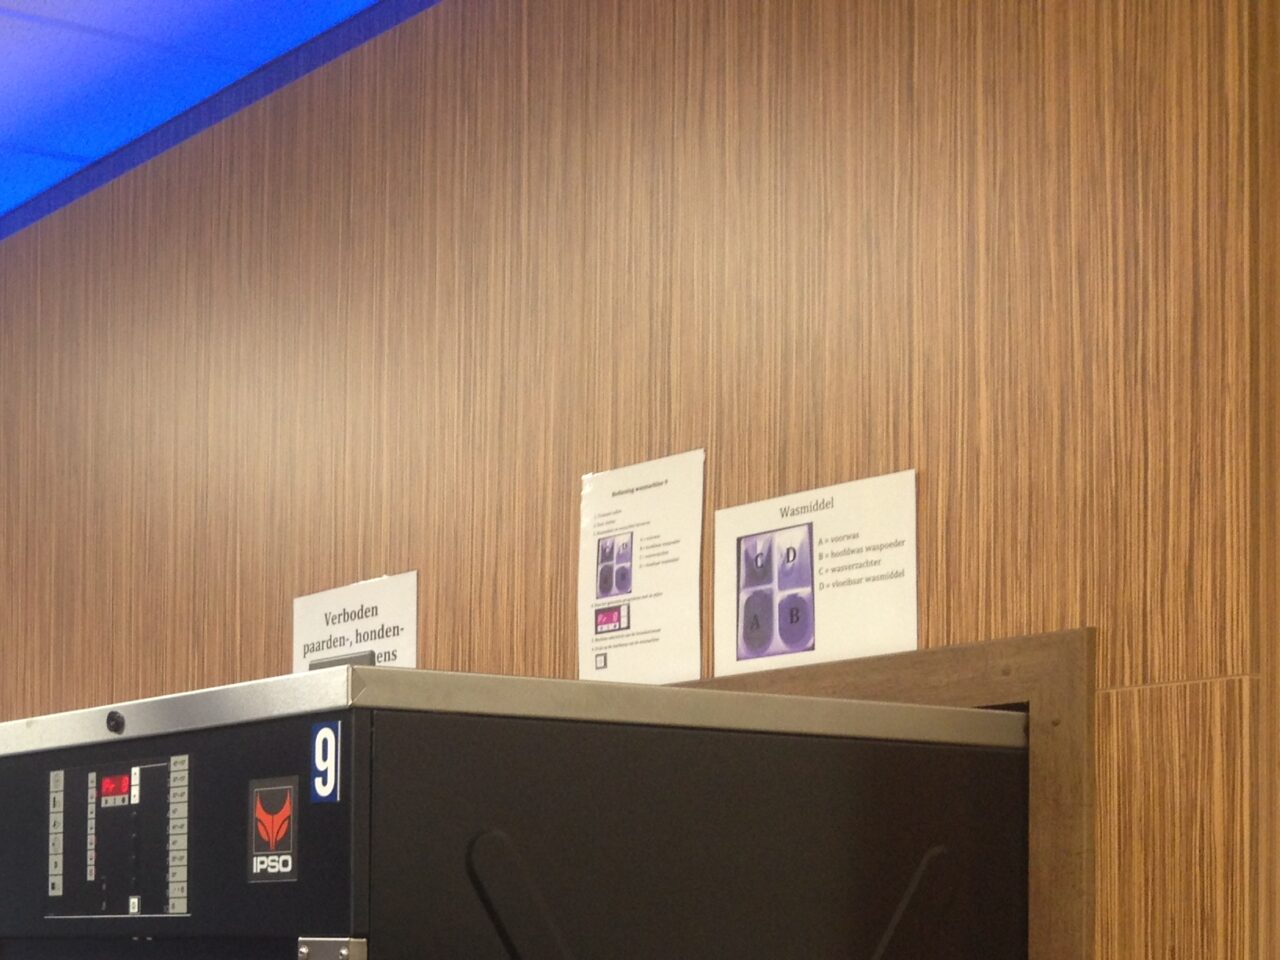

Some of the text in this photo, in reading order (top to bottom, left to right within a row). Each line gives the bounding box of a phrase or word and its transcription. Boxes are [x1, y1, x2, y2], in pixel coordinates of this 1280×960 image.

[780, 496, 834, 519] Wasmiddel
[830, 531, 860, 544] voorwas
[754, 546, 797, 569] C D
[324, 604, 379, 627] Verboden
[750, 606, 800, 631] A B
[303, 623, 405, 659] paarden-, honden-
[314, 726, 336, 798] 9
[253, 855, 293, 873] IPSO
